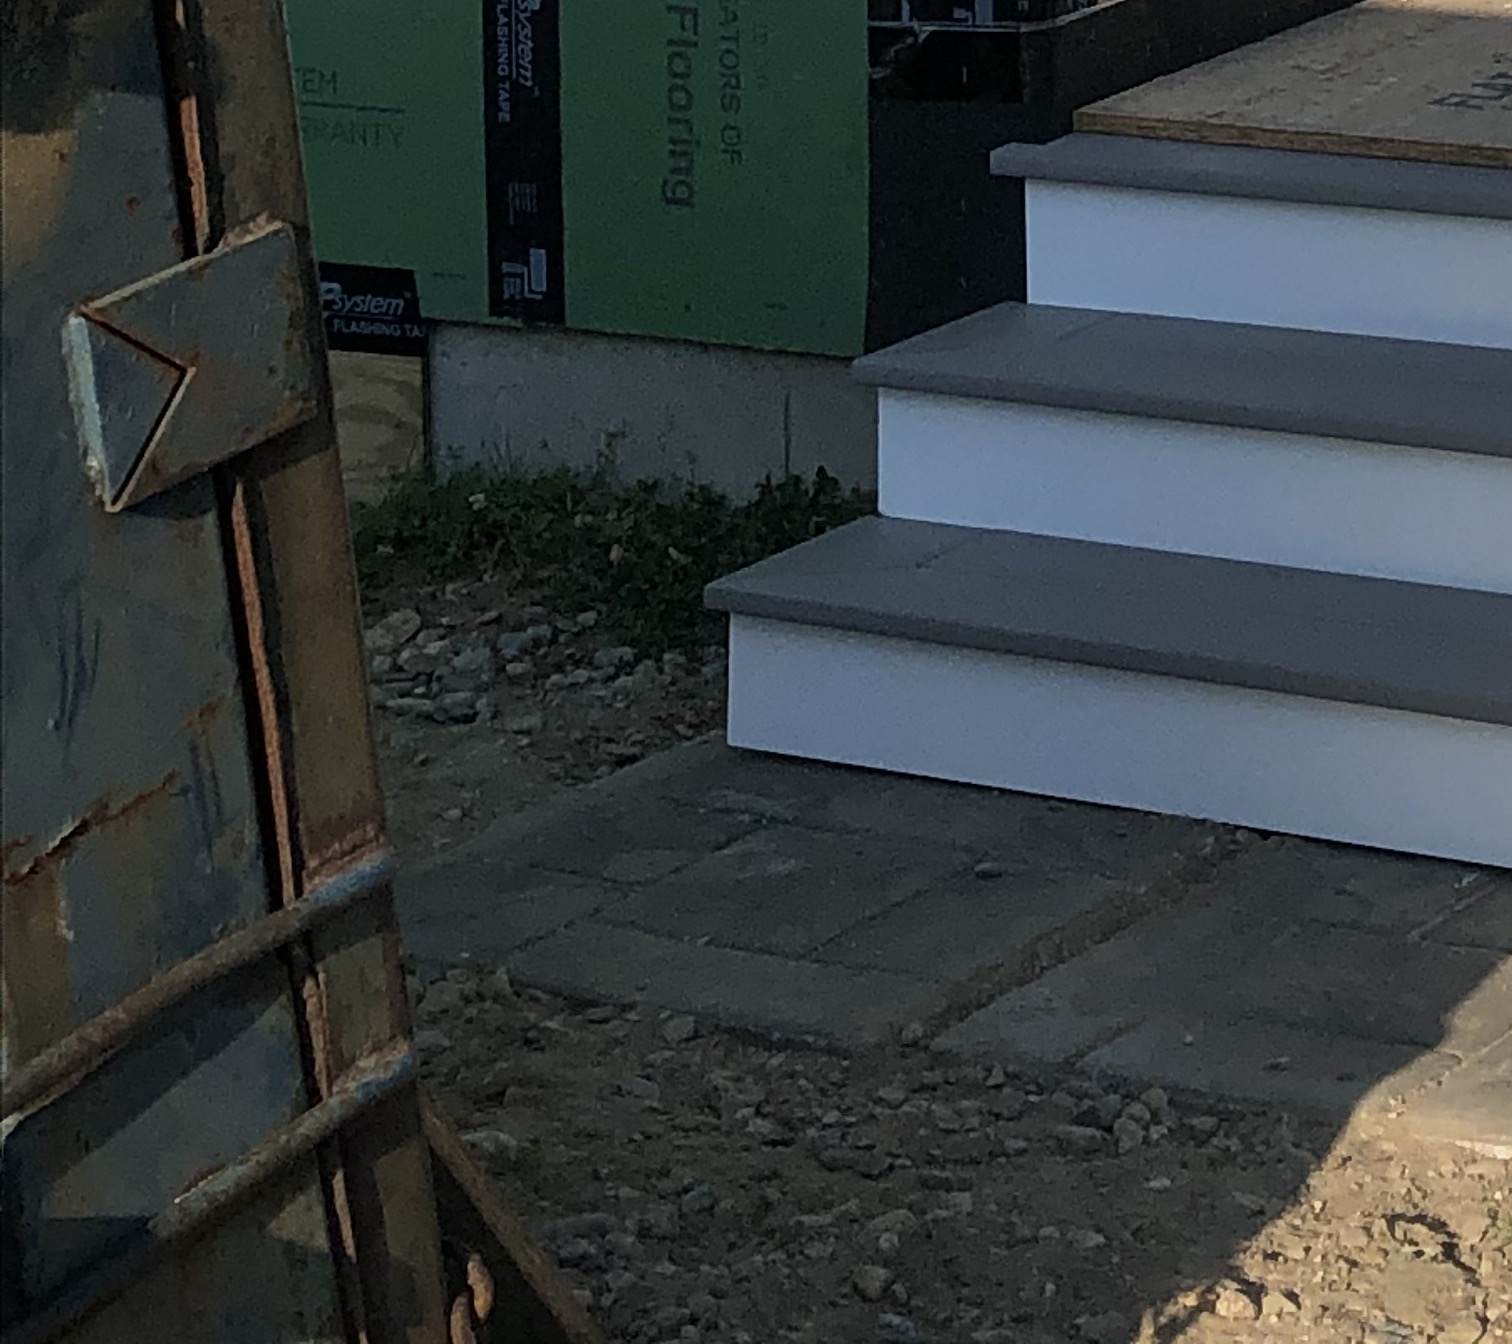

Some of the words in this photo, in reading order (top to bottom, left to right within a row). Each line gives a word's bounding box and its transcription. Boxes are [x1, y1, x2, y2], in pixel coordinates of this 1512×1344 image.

[498, 80, 512, 123] TAPE
[720, 123, 744, 167] OF
[332, 318, 400, 337] FLASHING
